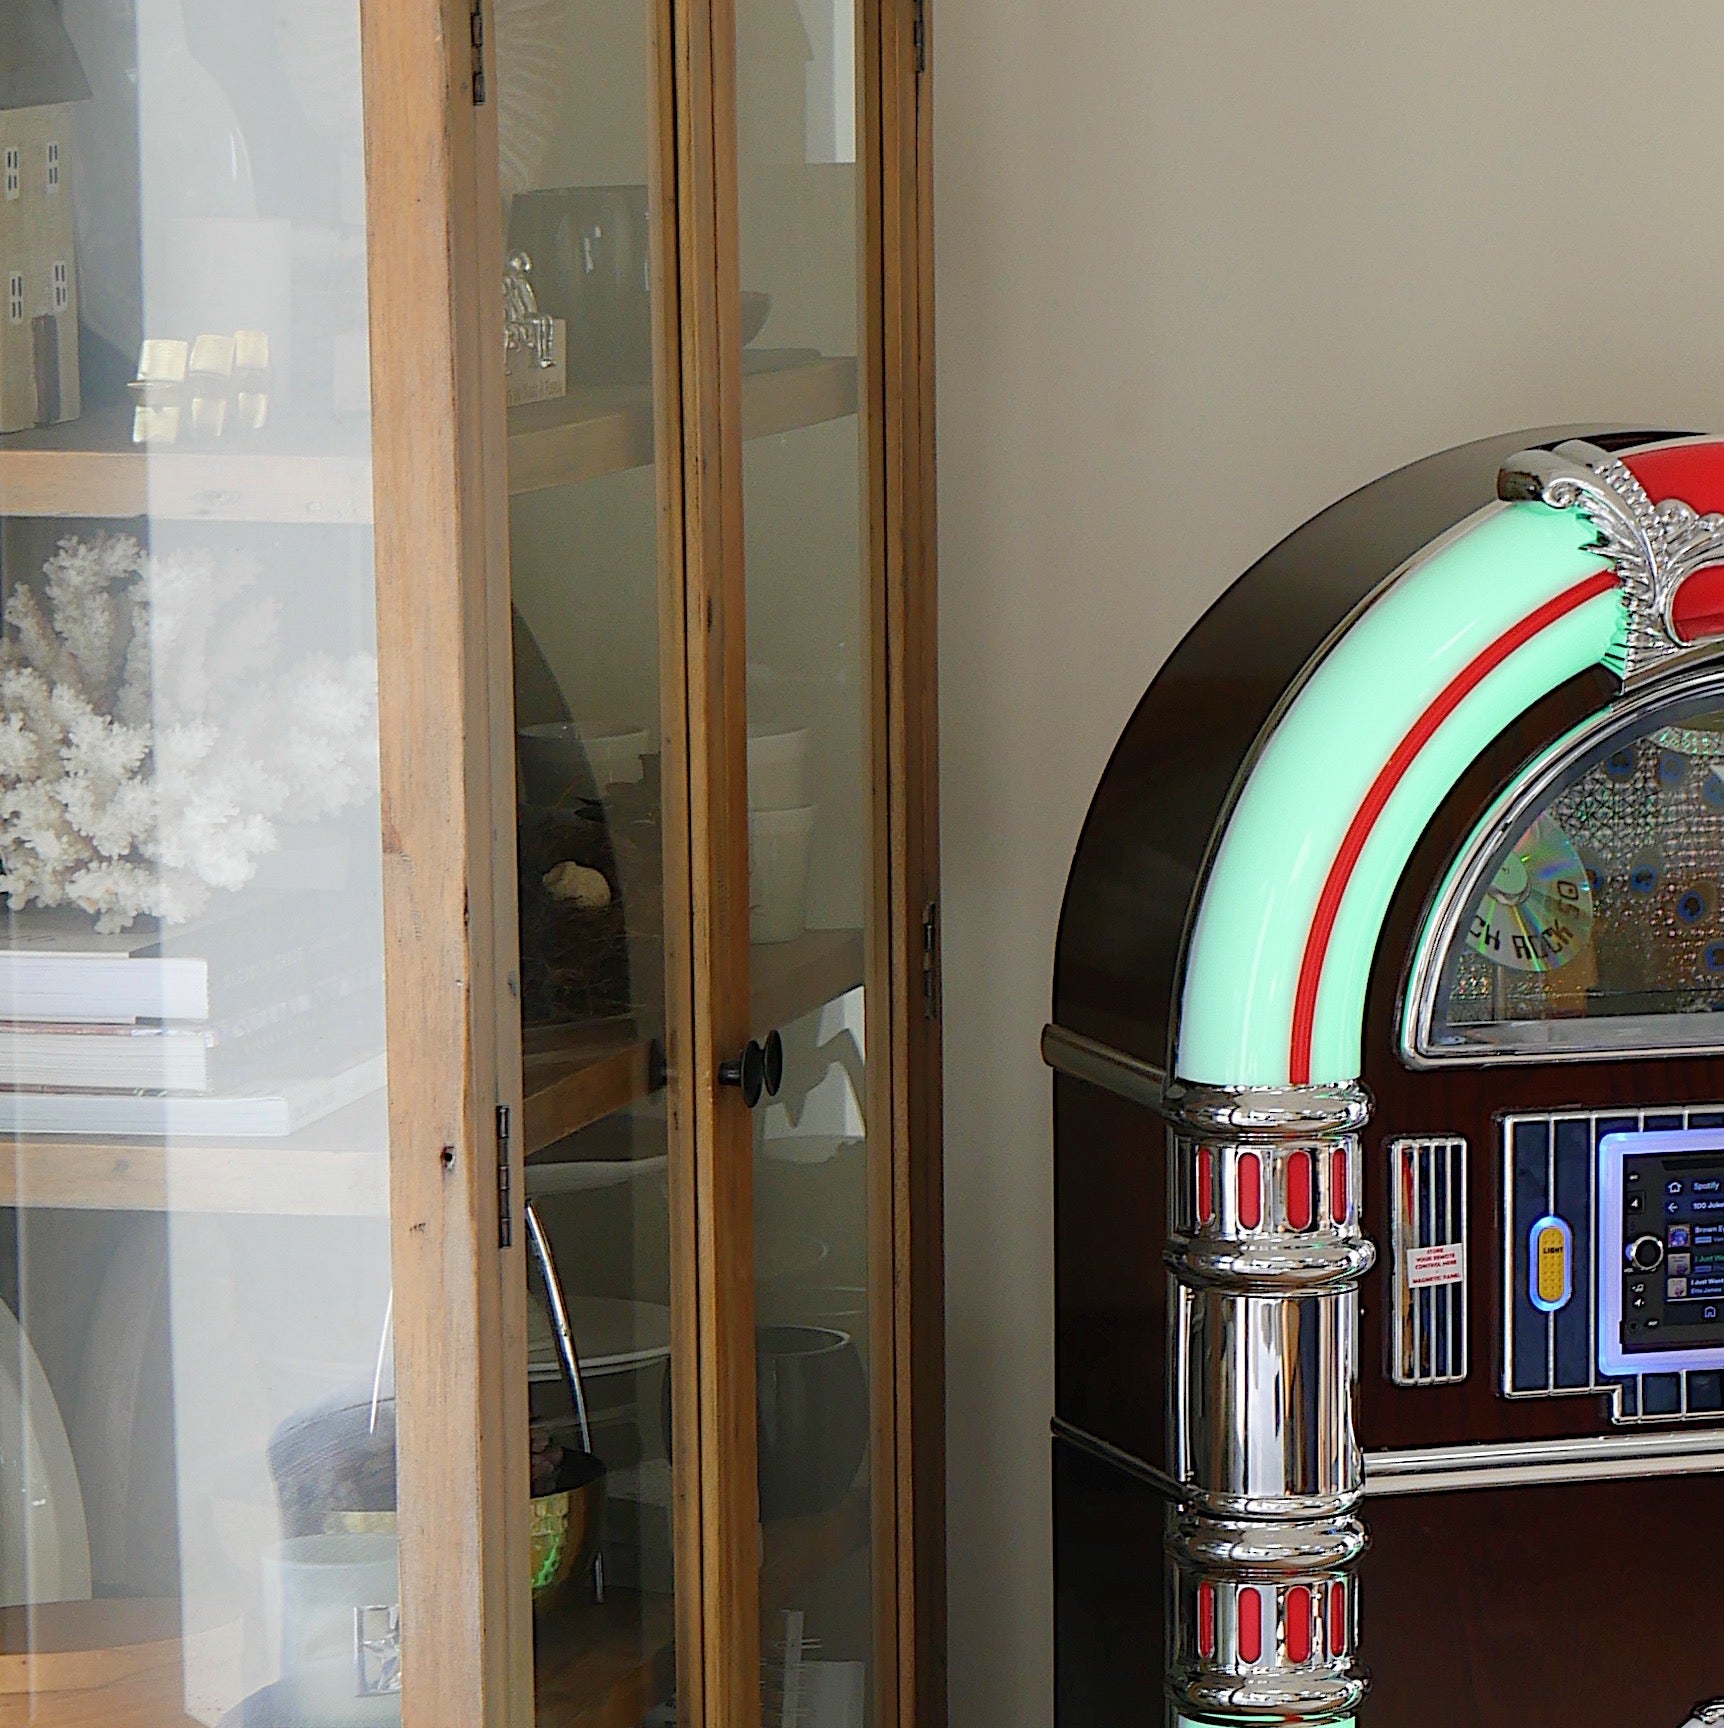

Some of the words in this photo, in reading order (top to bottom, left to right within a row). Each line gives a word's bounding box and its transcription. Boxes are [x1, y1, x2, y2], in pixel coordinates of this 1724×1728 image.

[1511, 919, 1574, 960] ROCK
[1694, 1182, 1719, 1191] Spotify
[1693, 1202, 1706, 1210] 100
[1695, 1226, 1717, 1234] Brown
[1543, 1246, 1563, 1254] LIGHT
